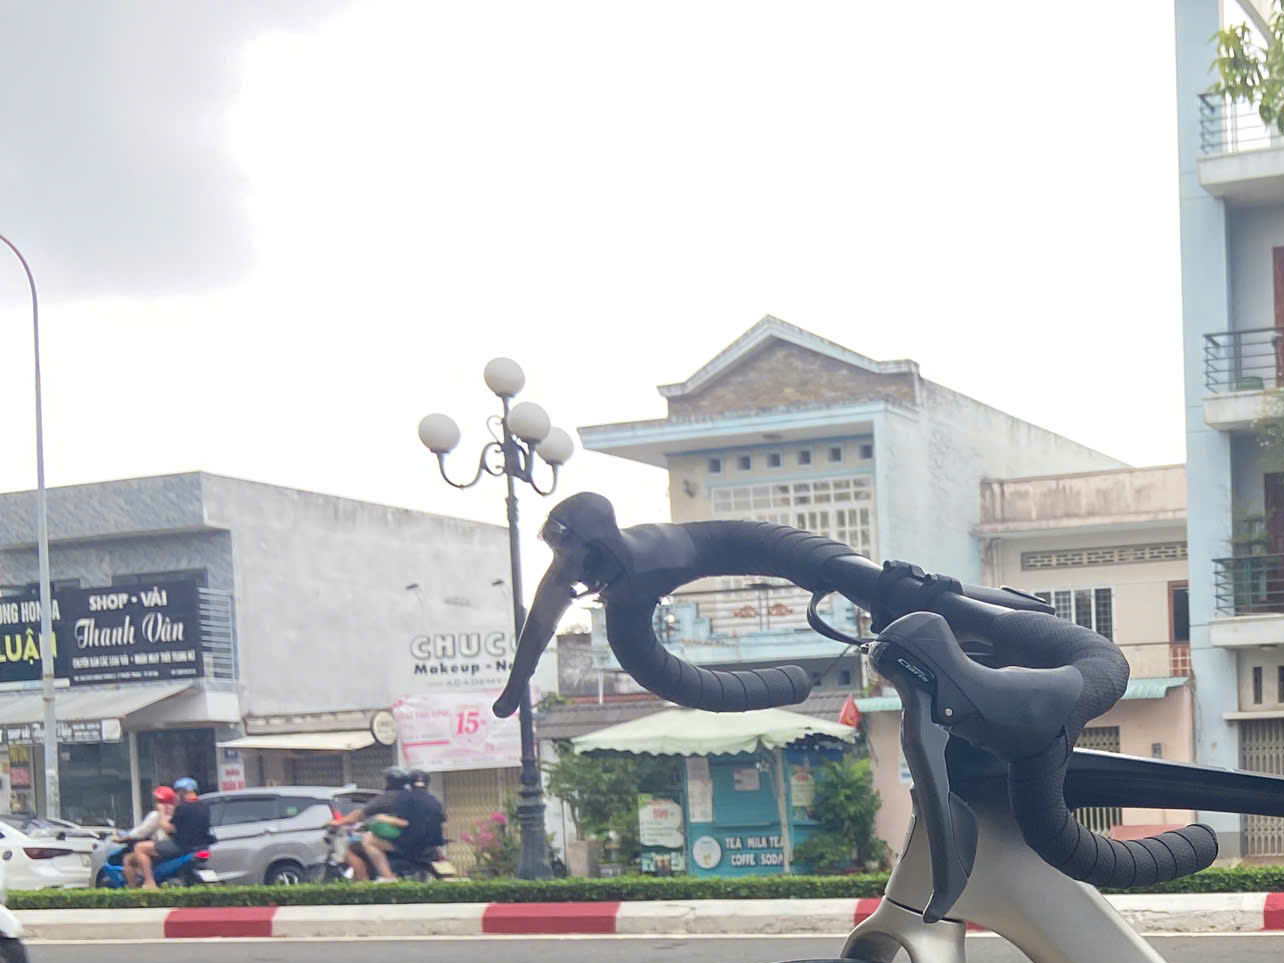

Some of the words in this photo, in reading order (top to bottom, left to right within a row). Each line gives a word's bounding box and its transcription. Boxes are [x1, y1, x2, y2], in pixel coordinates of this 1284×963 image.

[20, 598, 60, 623] HONA
[89, 593, 129, 612] SHOP
[74, 615, 136, 649] Thanh
[414, 660, 480, 676] Makeup
